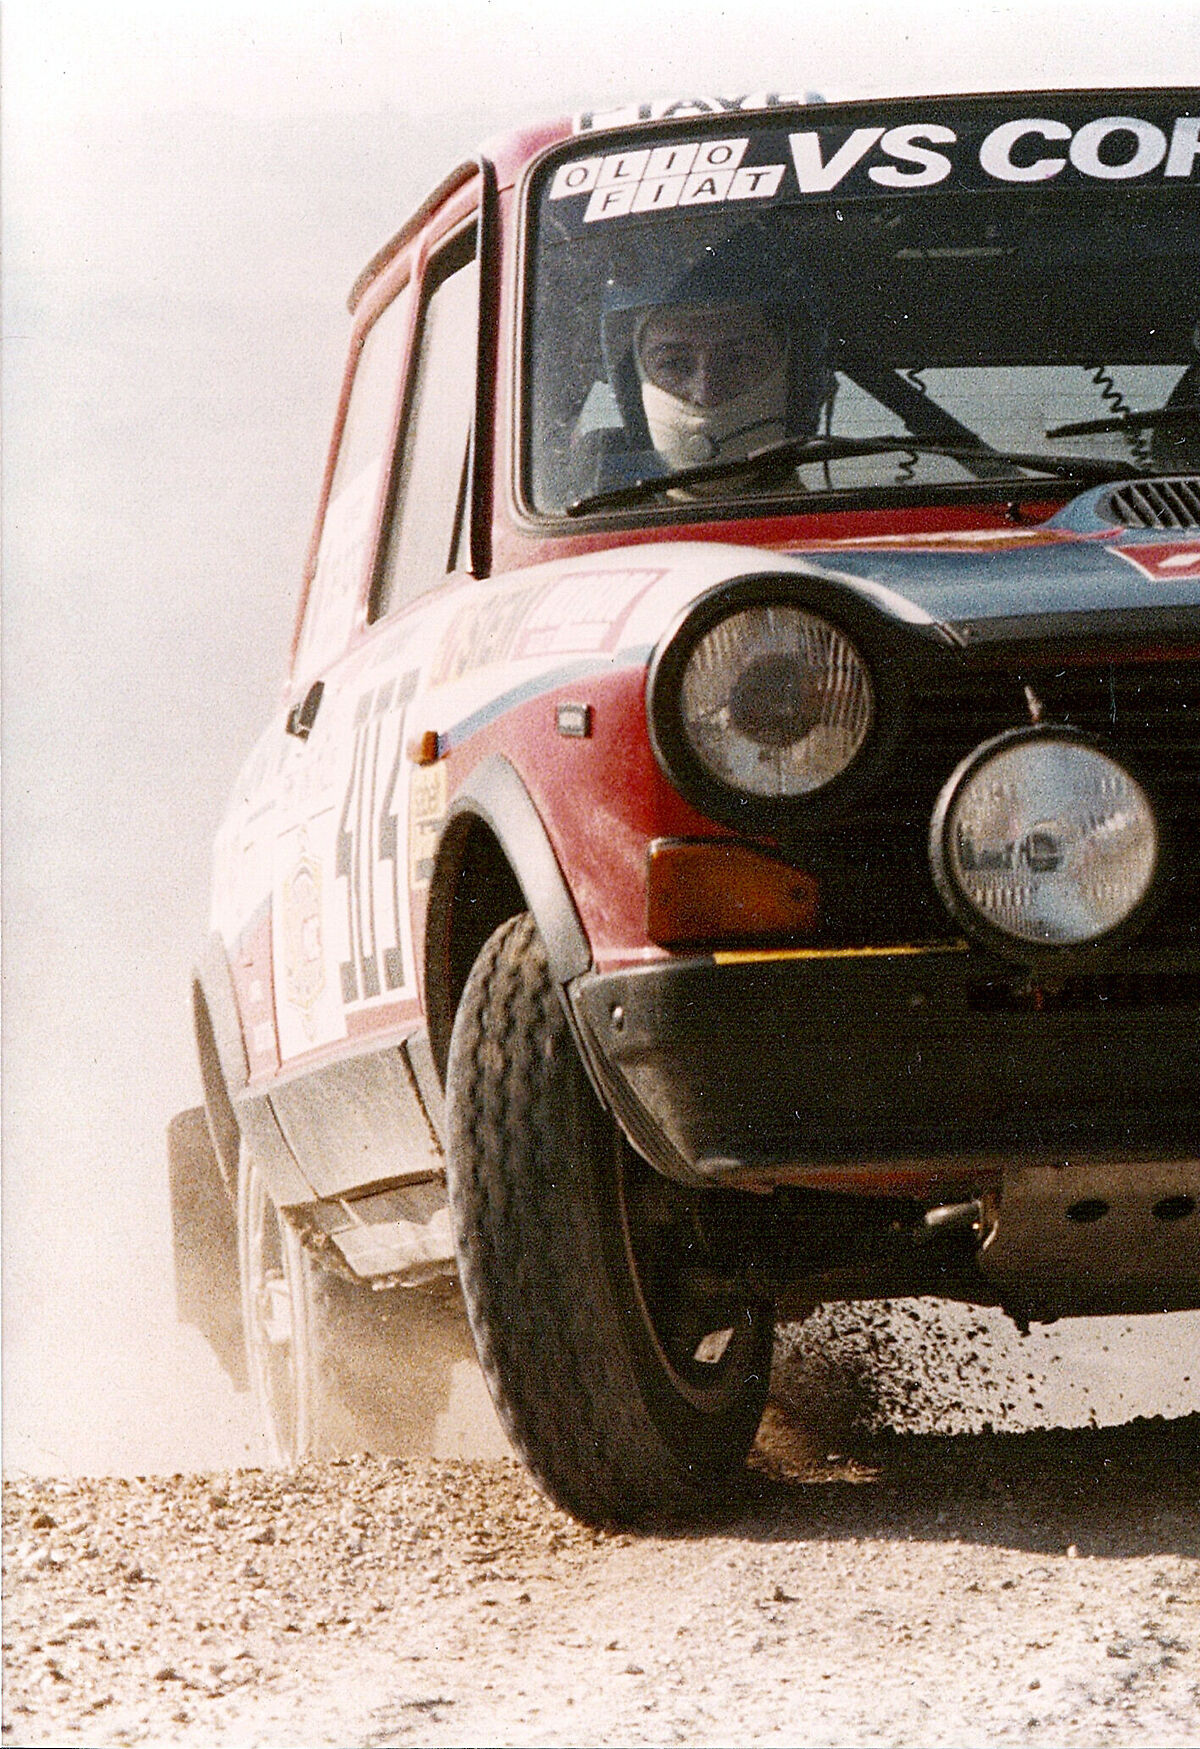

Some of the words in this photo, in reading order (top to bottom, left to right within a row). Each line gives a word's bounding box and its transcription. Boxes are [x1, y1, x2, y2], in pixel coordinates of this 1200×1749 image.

[564, 144, 734, 189] OLIO
[787, 122, 958, 194] VS
[599, 170, 773, 213] FIAT
